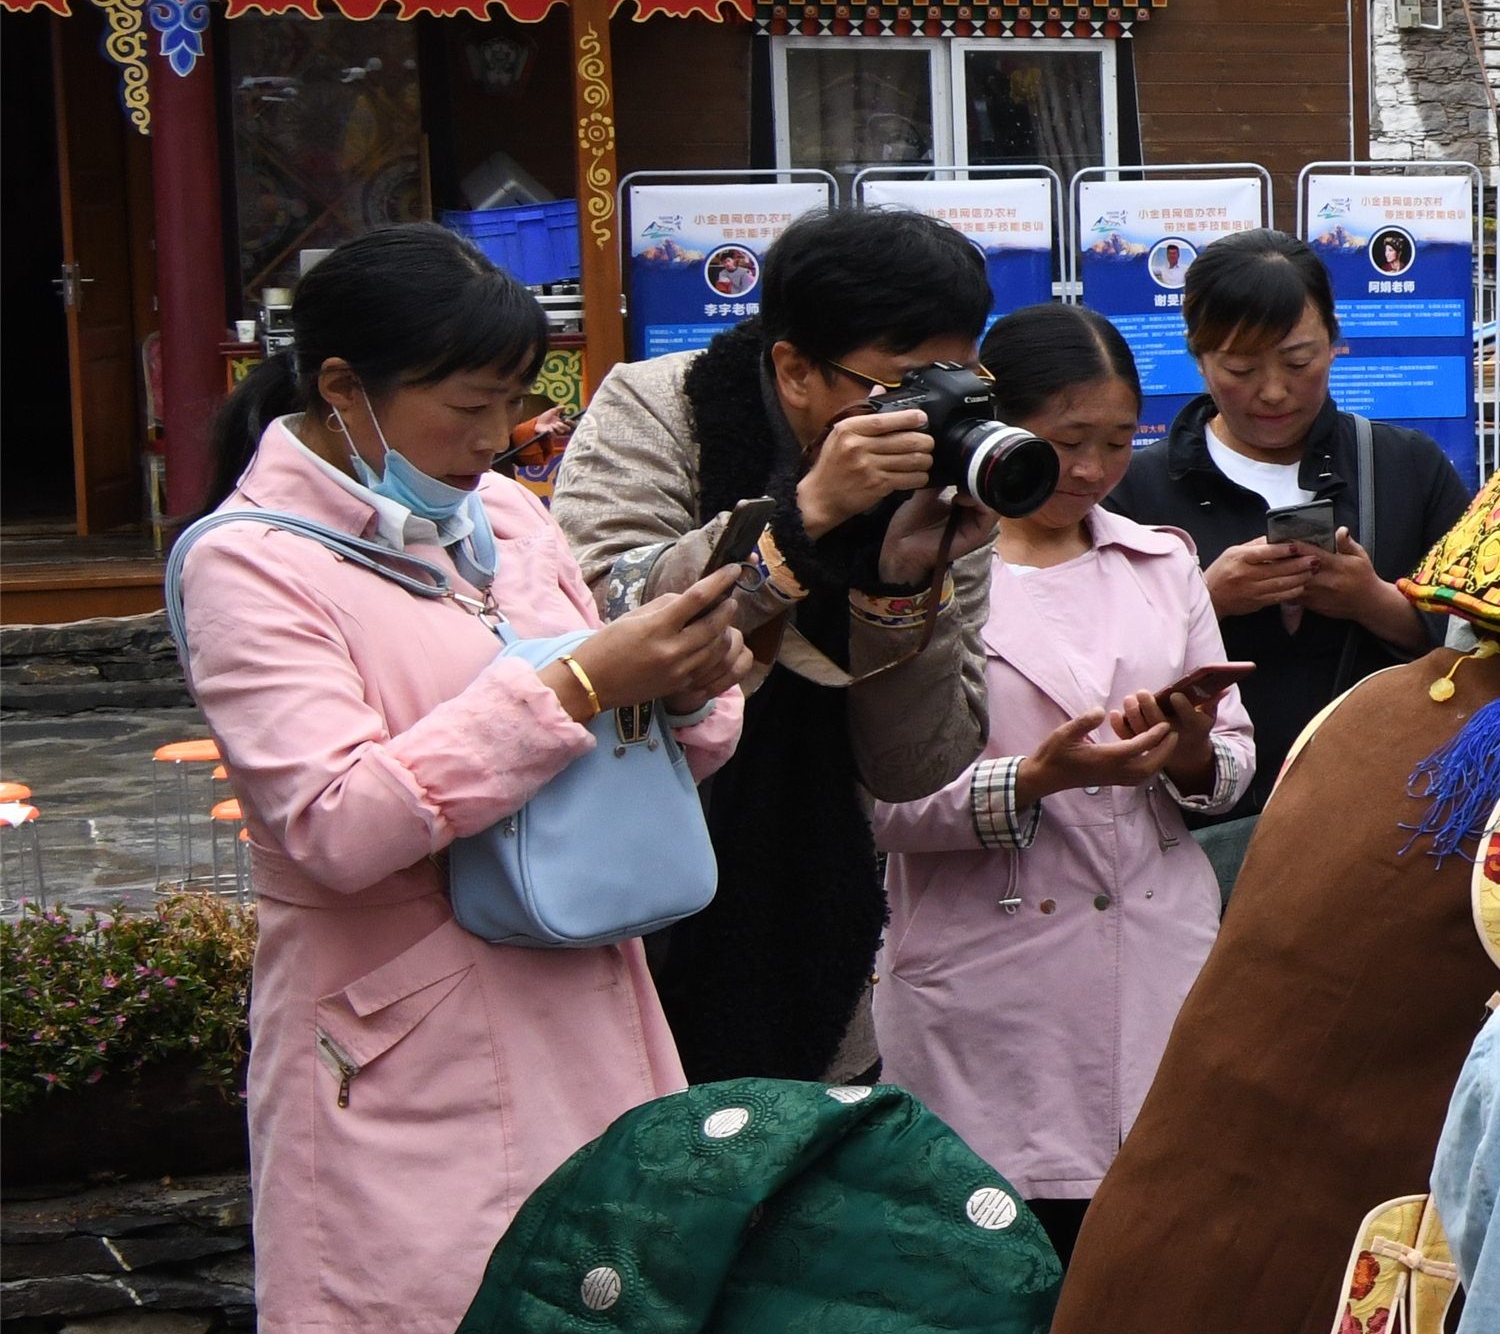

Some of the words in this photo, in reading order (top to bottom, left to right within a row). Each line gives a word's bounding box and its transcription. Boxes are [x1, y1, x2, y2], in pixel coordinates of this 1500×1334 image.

[1138, 208, 1227, 219] 小金县网信办农村
[1164, 220, 1254, 232] 带货能手技能培训
[1368, 281, 1416, 294] 阿娟老师
[704, 303, 760, 317] 李宇老师
